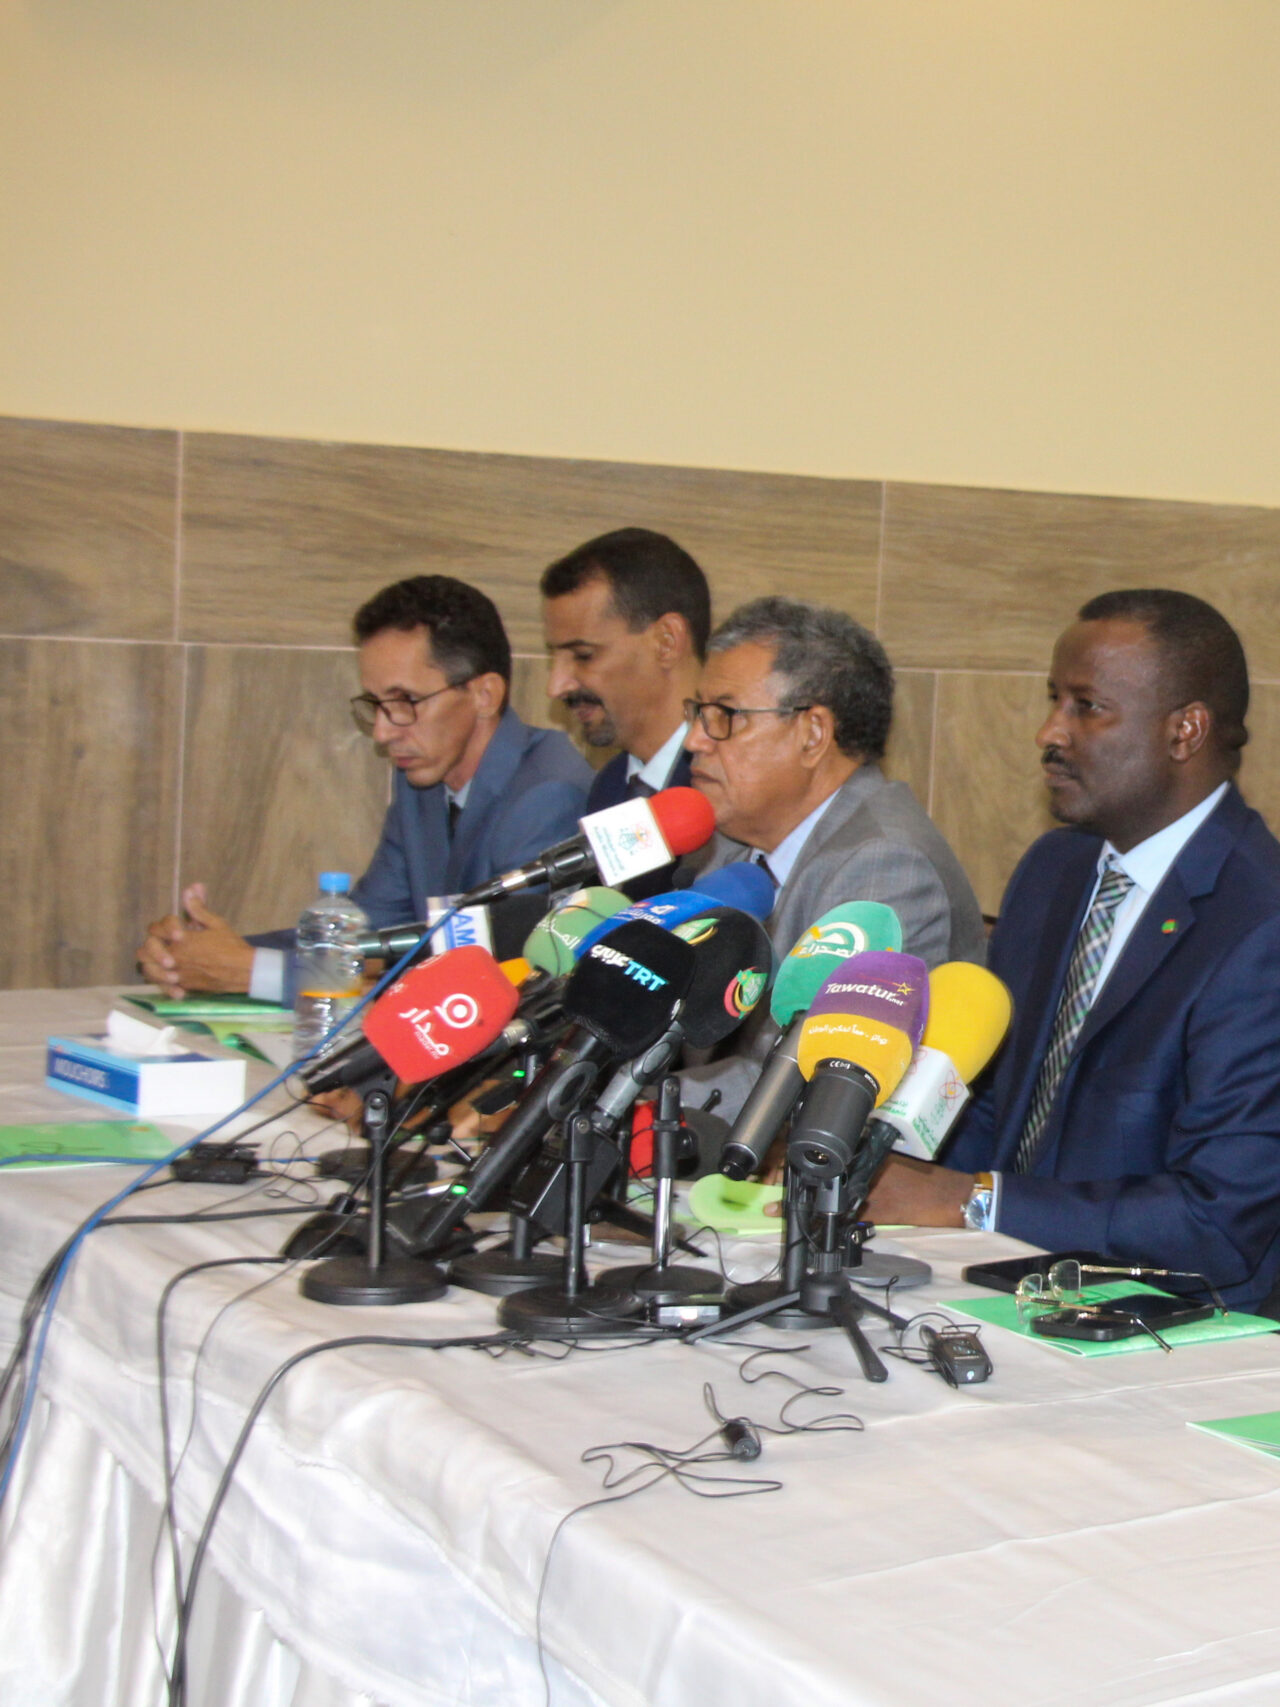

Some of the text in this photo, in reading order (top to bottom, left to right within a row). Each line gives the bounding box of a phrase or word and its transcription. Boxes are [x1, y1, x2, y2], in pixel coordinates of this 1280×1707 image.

[453, 913, 477, 946] AM
[591, 944, 670, 992] TRT عربي
